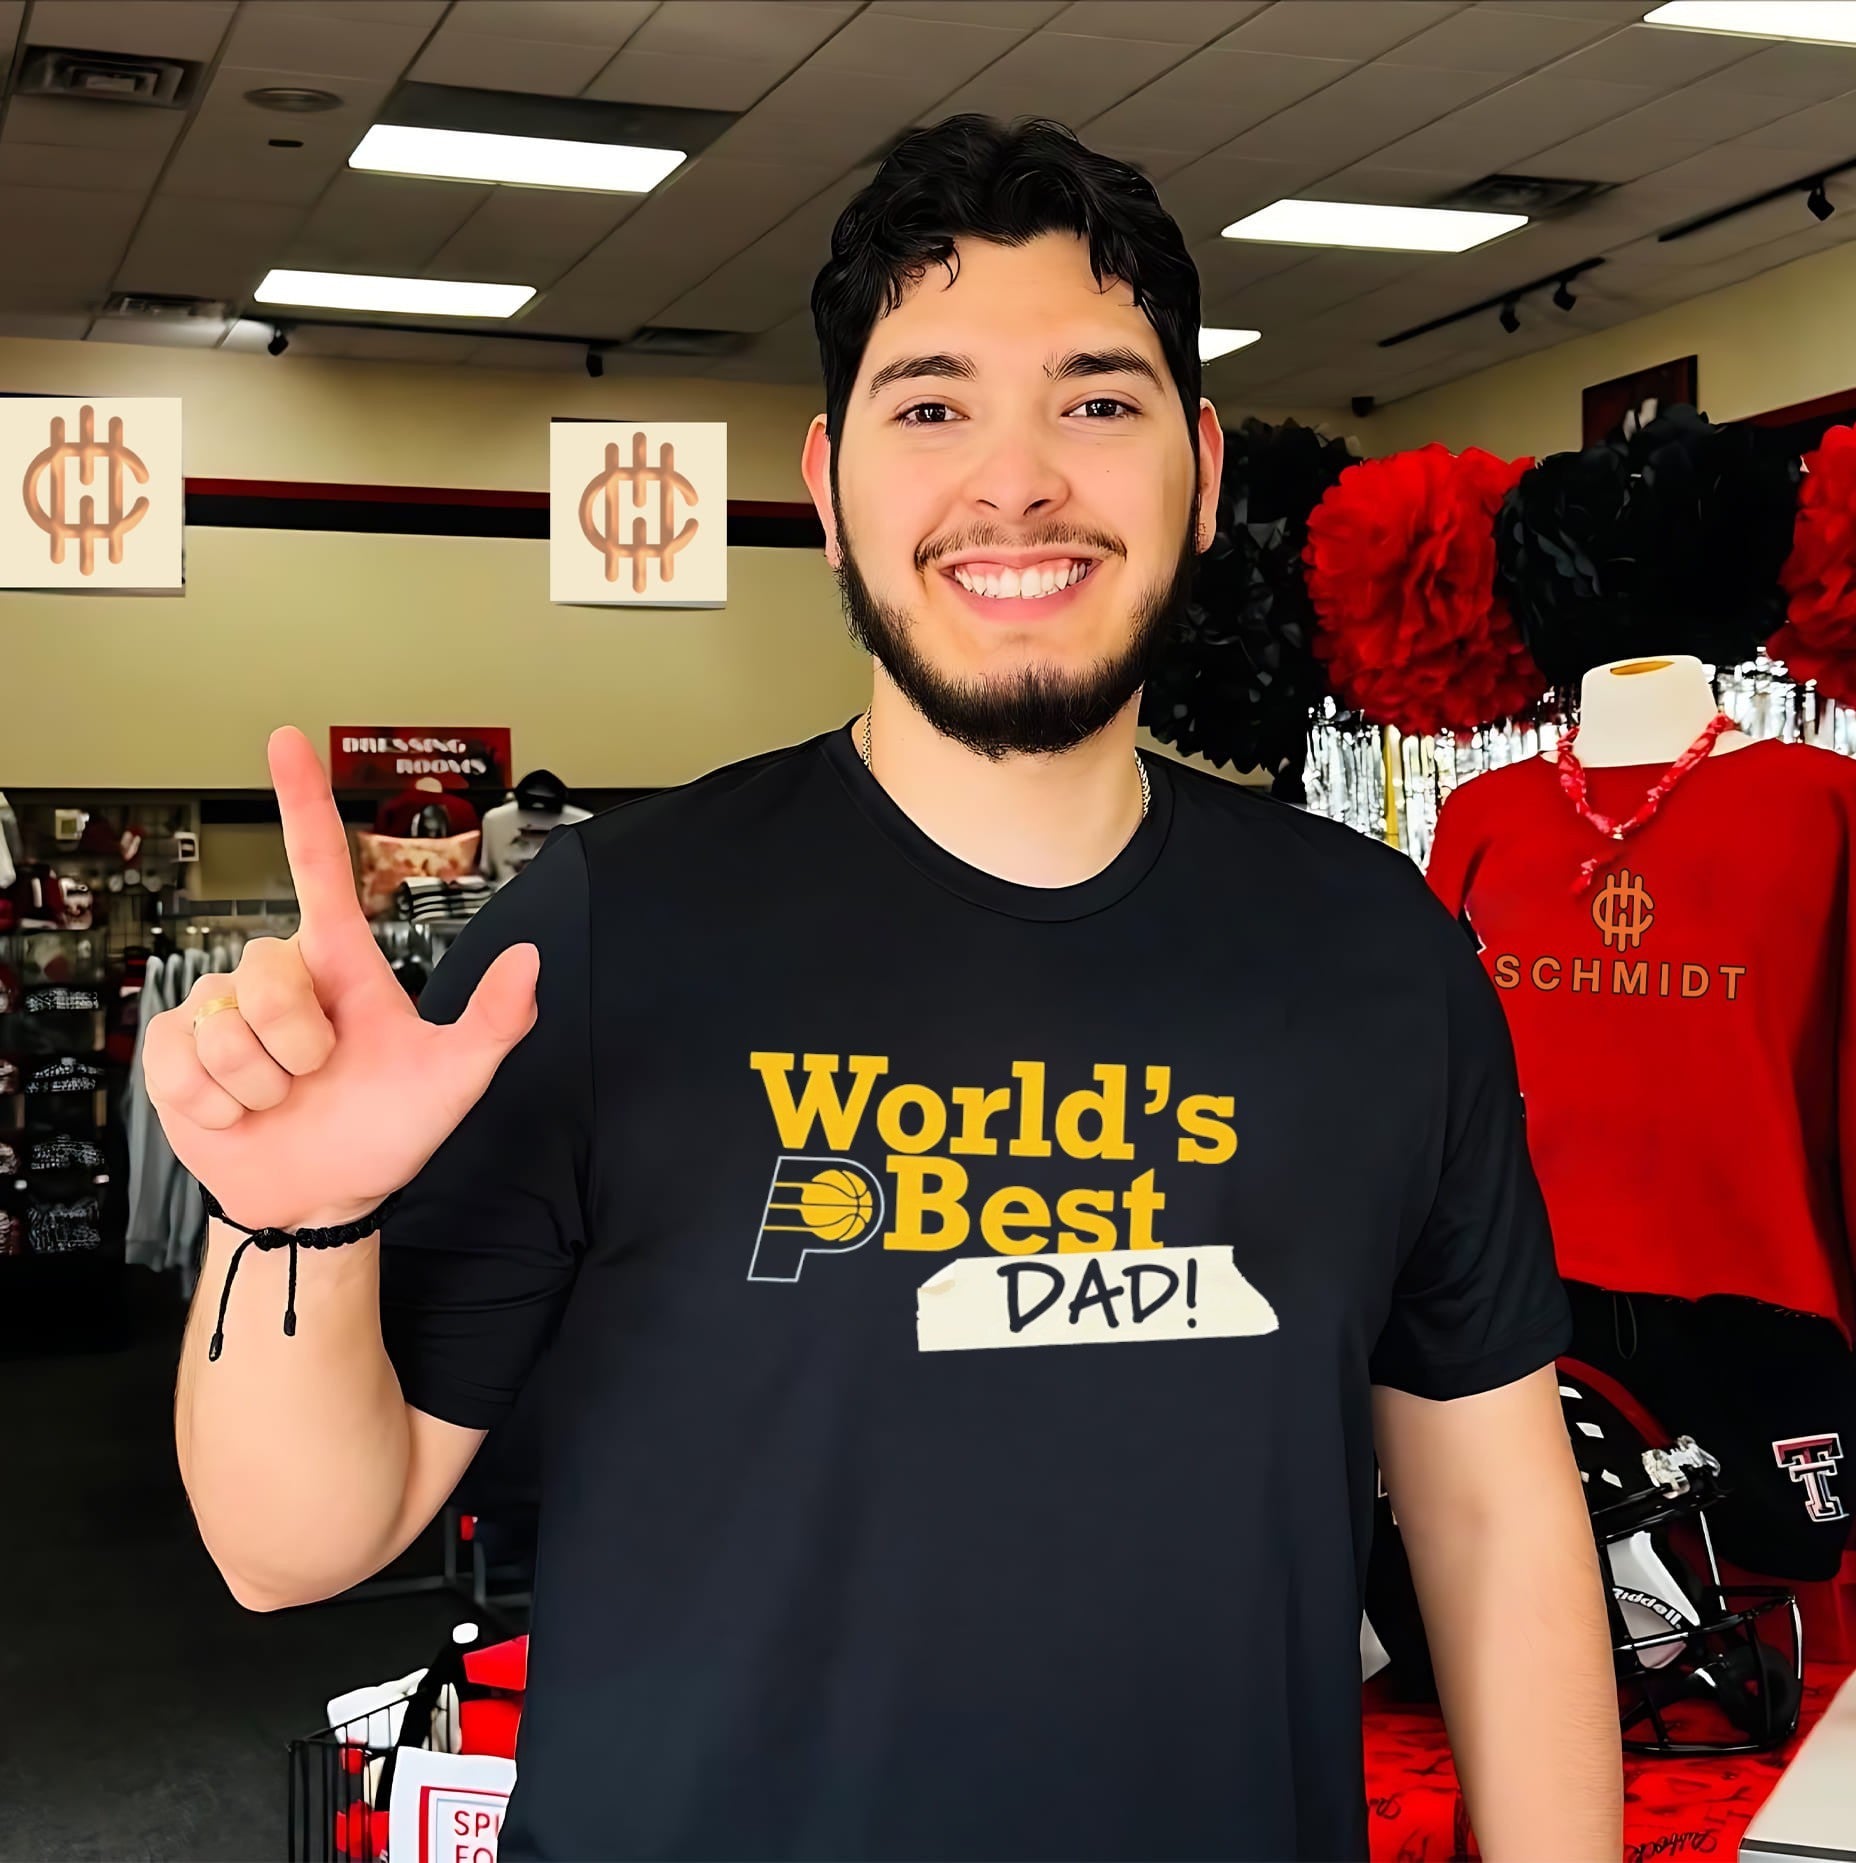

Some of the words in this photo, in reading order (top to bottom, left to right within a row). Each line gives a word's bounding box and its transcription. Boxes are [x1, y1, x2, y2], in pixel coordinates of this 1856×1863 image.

[1494, 953, 1746, 1000] SCHMIDT
[749, 1051, 1238, 1165] World's
[883, 1155, 1165, 1256] Best
[996, 1258, 1197, 1333] DAD!
